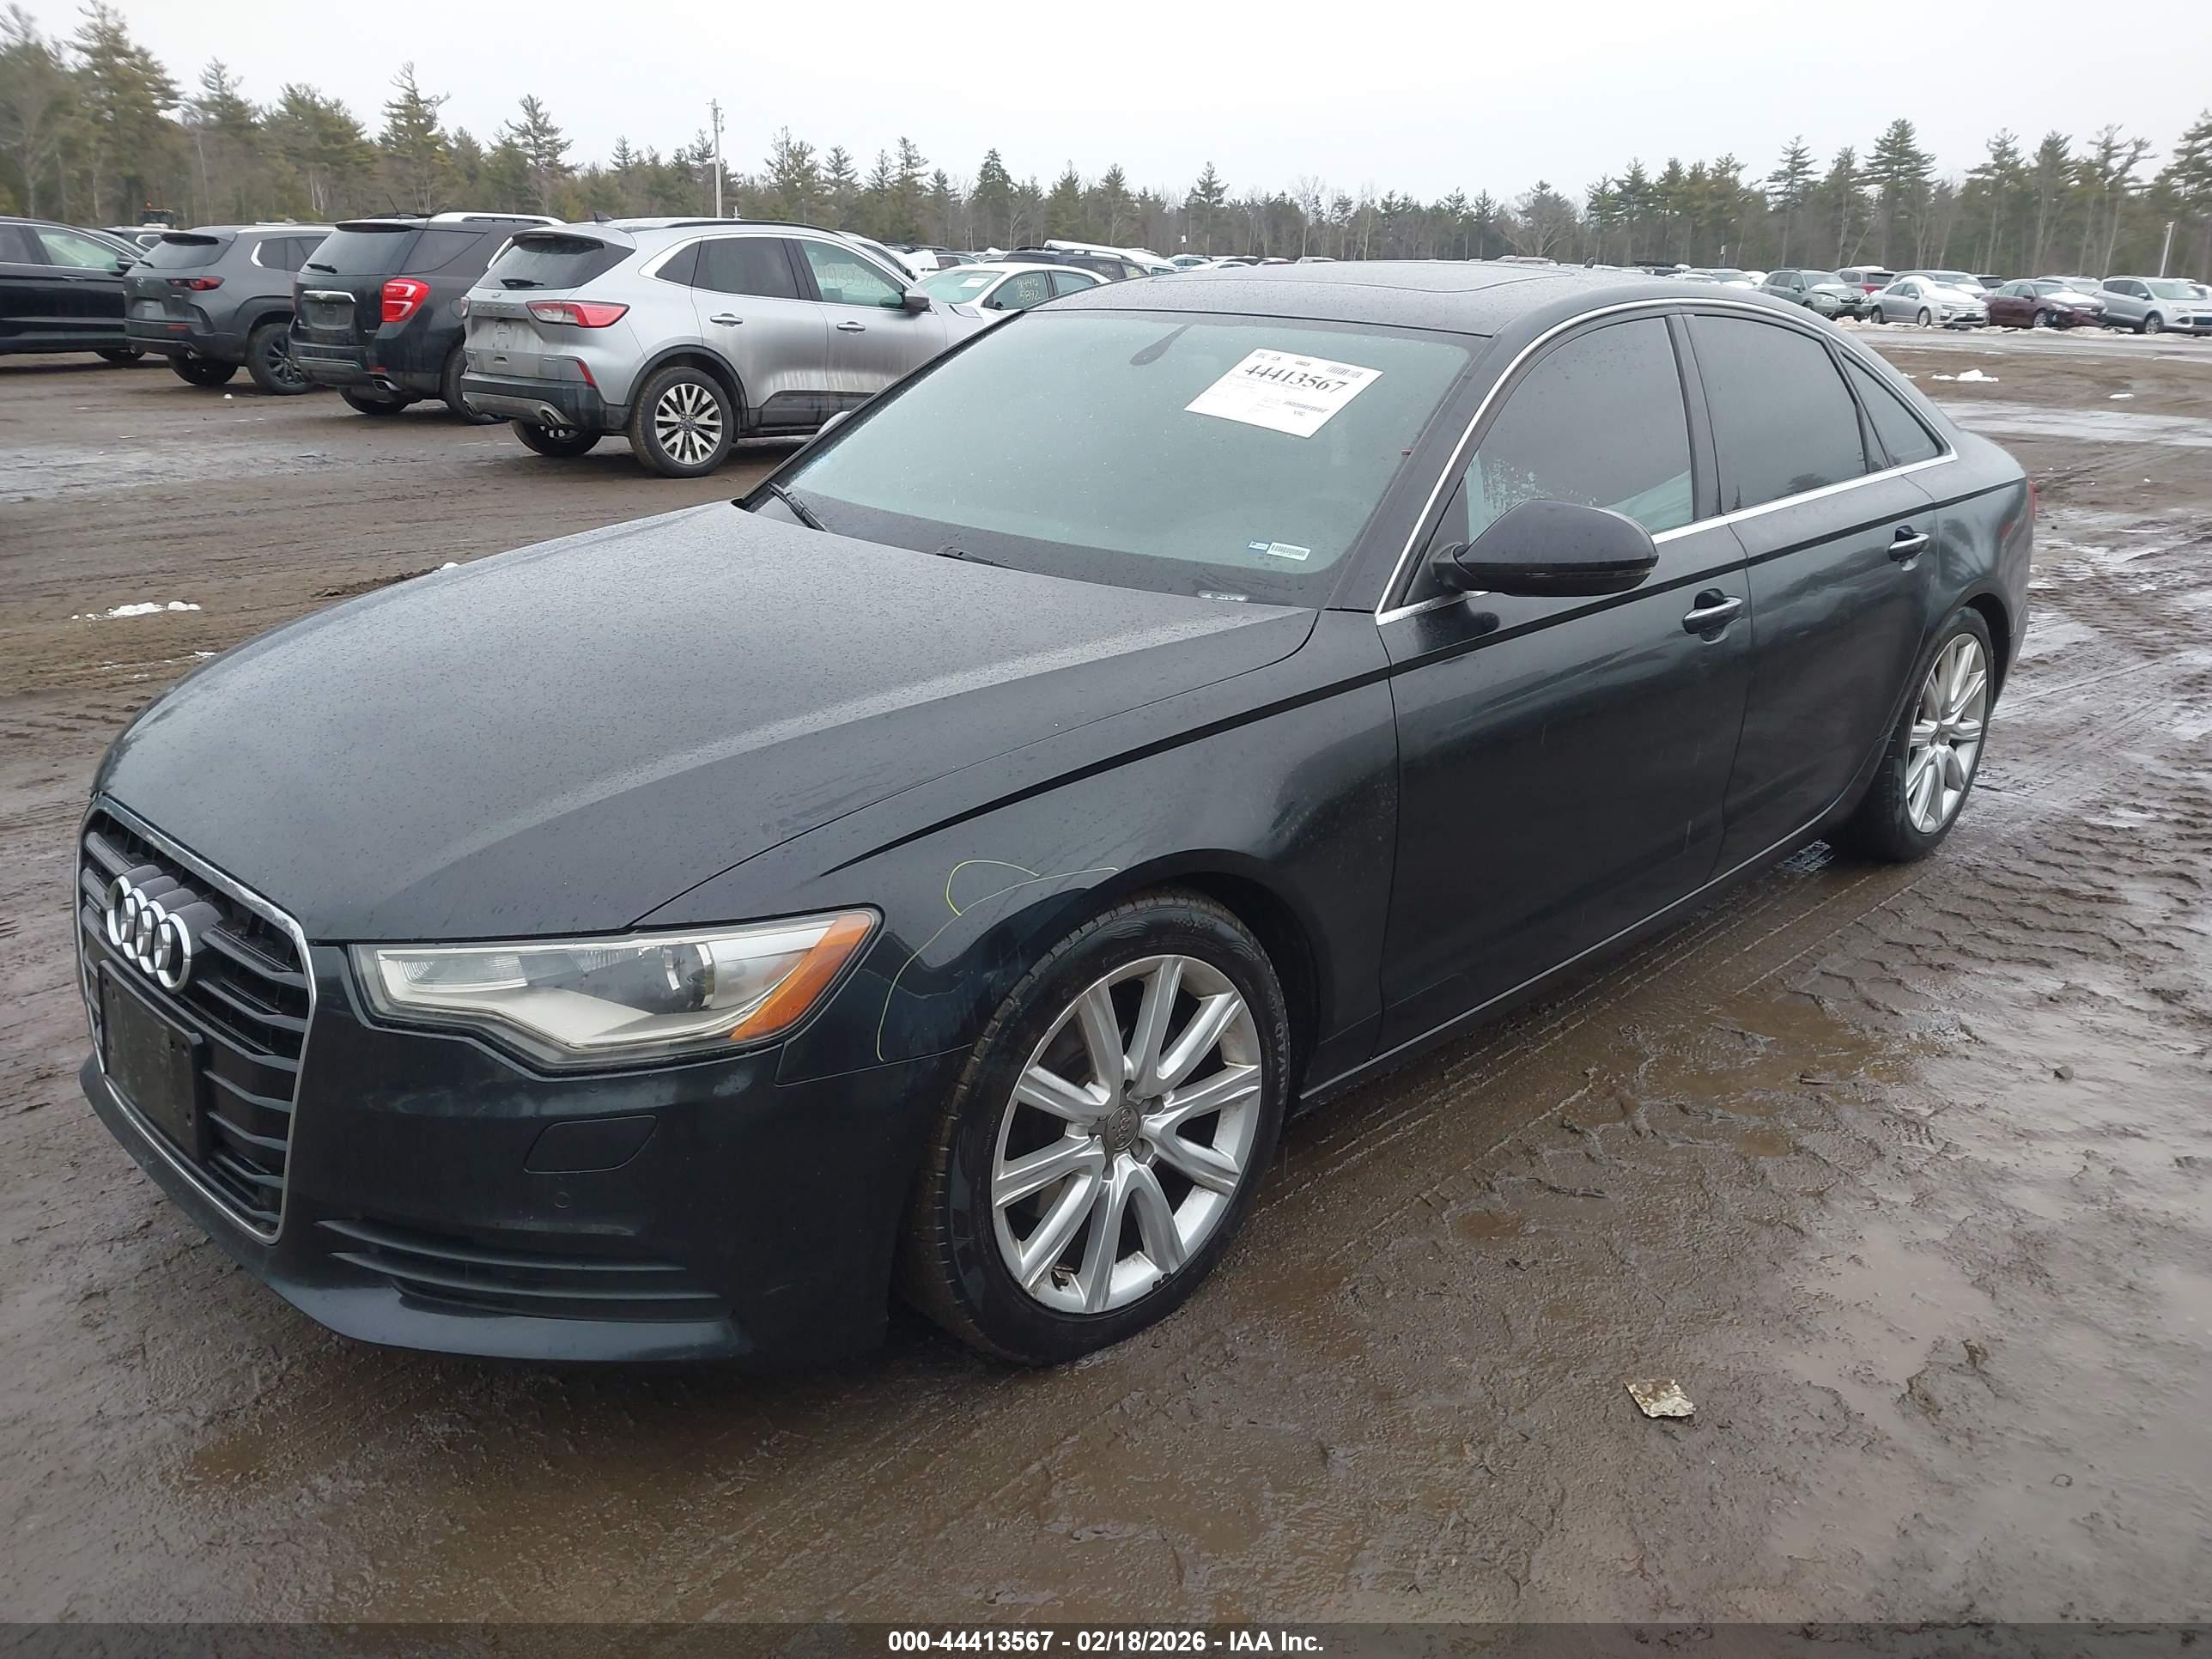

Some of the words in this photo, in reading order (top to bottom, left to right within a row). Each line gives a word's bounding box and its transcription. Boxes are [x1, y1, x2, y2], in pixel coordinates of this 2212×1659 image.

[1017, 276, 1039, 288] 4440
[1018, 289, 1041, 302] 5892
[1244, 364, 1349, 392] 44413567
